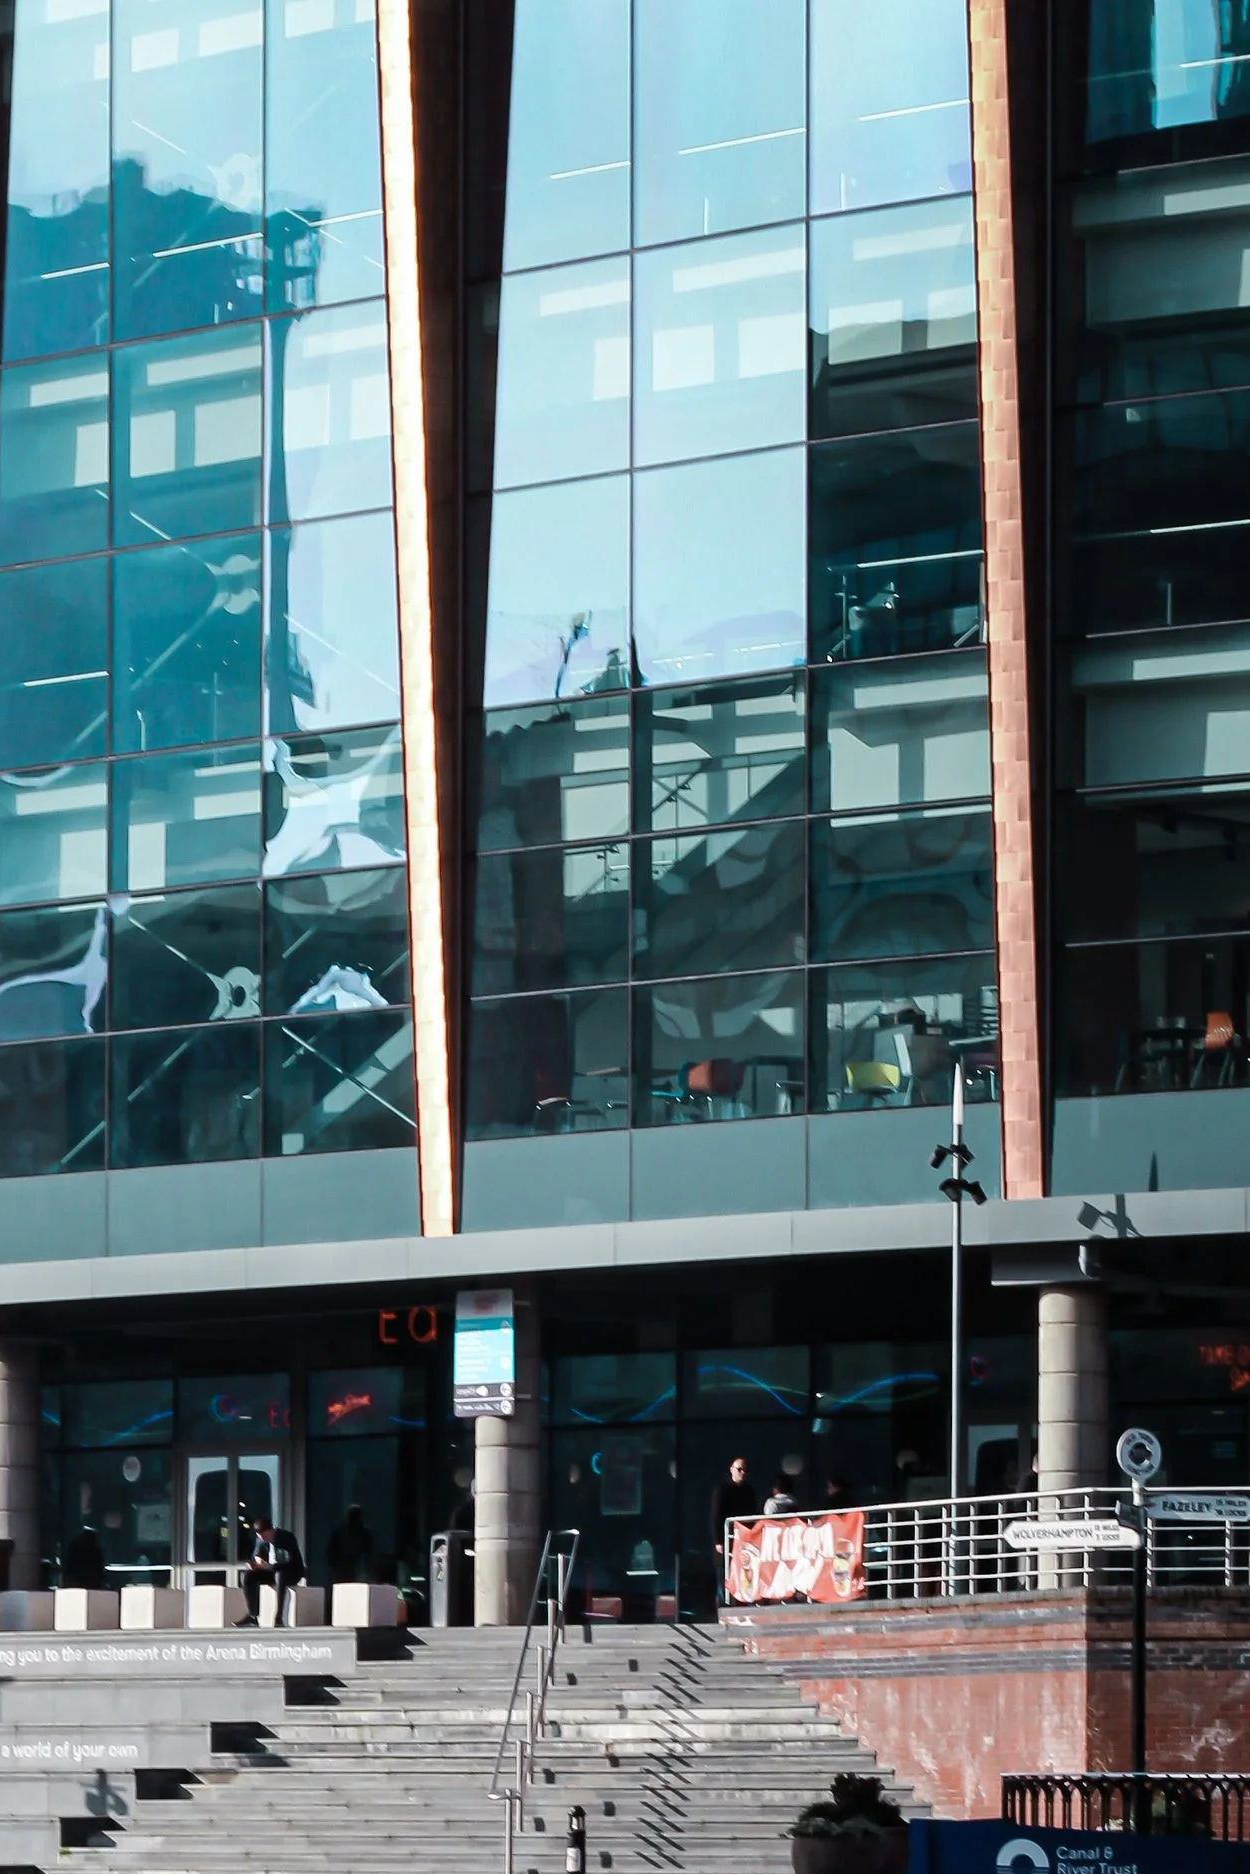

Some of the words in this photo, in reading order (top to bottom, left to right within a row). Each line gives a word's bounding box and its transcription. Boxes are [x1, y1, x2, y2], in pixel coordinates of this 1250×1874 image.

[1162, 1501, 1211, 1513] FAZELEY
[1012, 1527, 1093, 1540] WOLVERHAMPTON
[18, 1649, 42, 1666] you
[44, 1647, 58, 1663] to
[61, 1646, 83, 1662] the
[86, 1645, 159, 1661] excitement
[162, 1644, 177, 1661] of
[180, 1644, 203, 1661] the
[206, 1644, 247, 1661] Arena
[250, 1643, 332, 1663] Birmingham
[2, 1744, 10, 1758] a
[12, 1741, 51, 1758] world
[54, 1741, 70, 1758] of
[72, 1744, 105, 1762] your
[108, 1744, 138, 1758] own
[1056, 1846, 1100, 1860] Canal
[1103, 1846, 1113, 1860] &
